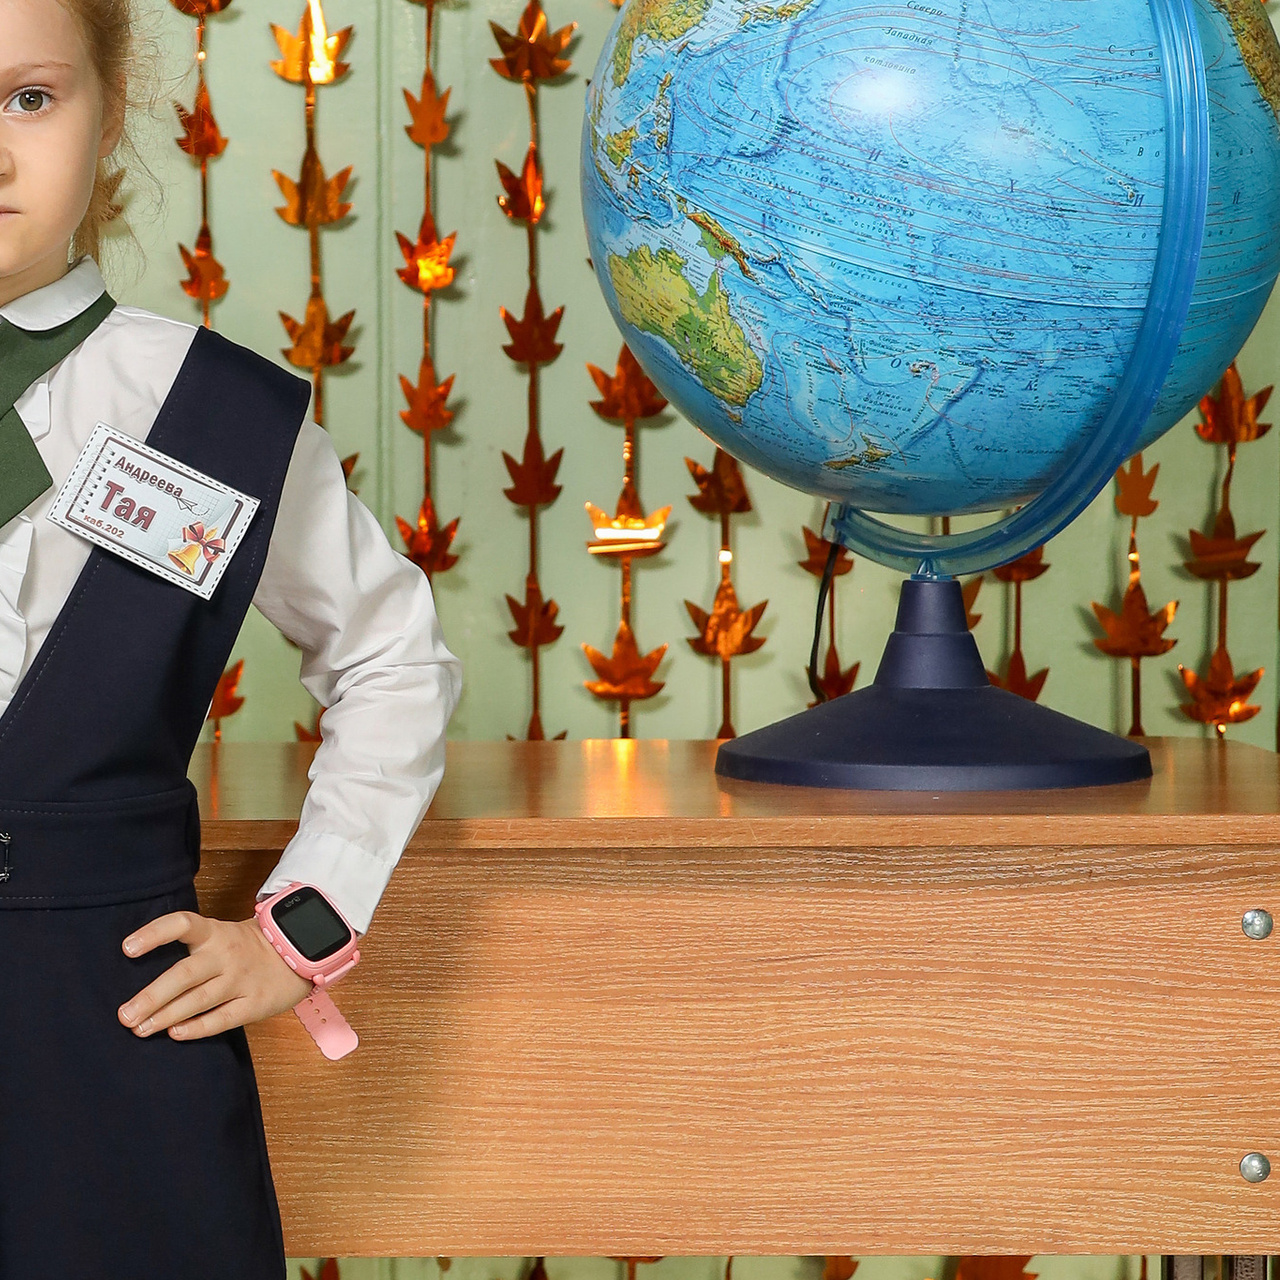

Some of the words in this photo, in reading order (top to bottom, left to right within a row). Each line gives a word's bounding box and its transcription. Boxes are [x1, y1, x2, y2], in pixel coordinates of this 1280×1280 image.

[906, 0, 948, 16] Северо-
[881, 26, 933, 46] -Западная
[864, 56, 917, 75] котловина
[114, 456, 184, 498] Андреева
[99, 480, 158, 532] Тая
[83, 514, 125, 539] каб.202
